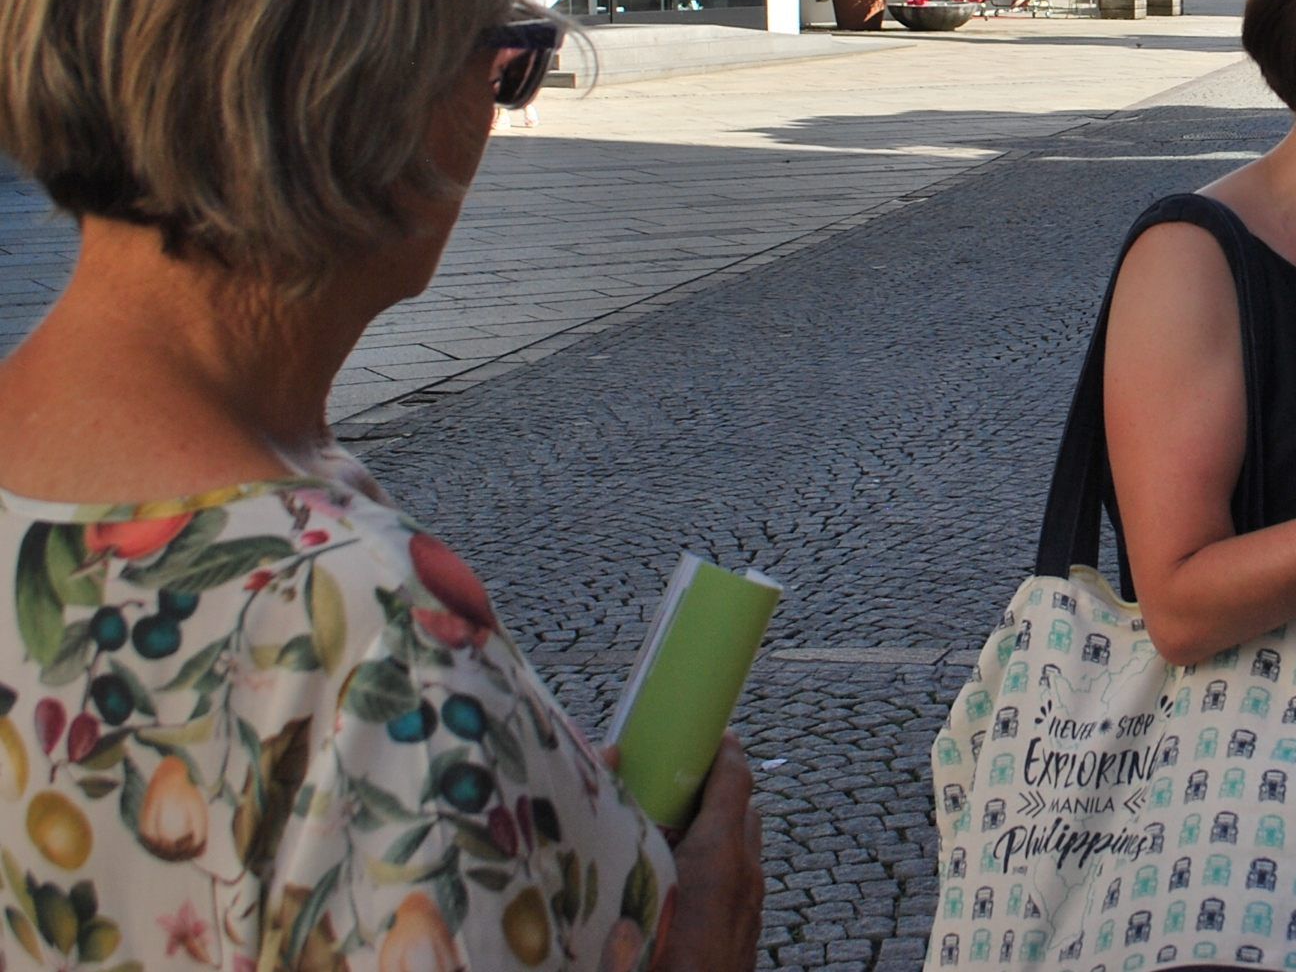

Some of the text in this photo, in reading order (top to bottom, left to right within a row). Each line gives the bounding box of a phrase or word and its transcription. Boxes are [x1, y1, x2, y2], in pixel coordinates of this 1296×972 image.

[1116, 713, 1155, 739] STOP
[1049, 797, 1115, 814] MANILA
[993, 817, 1148, 873] Philippines
